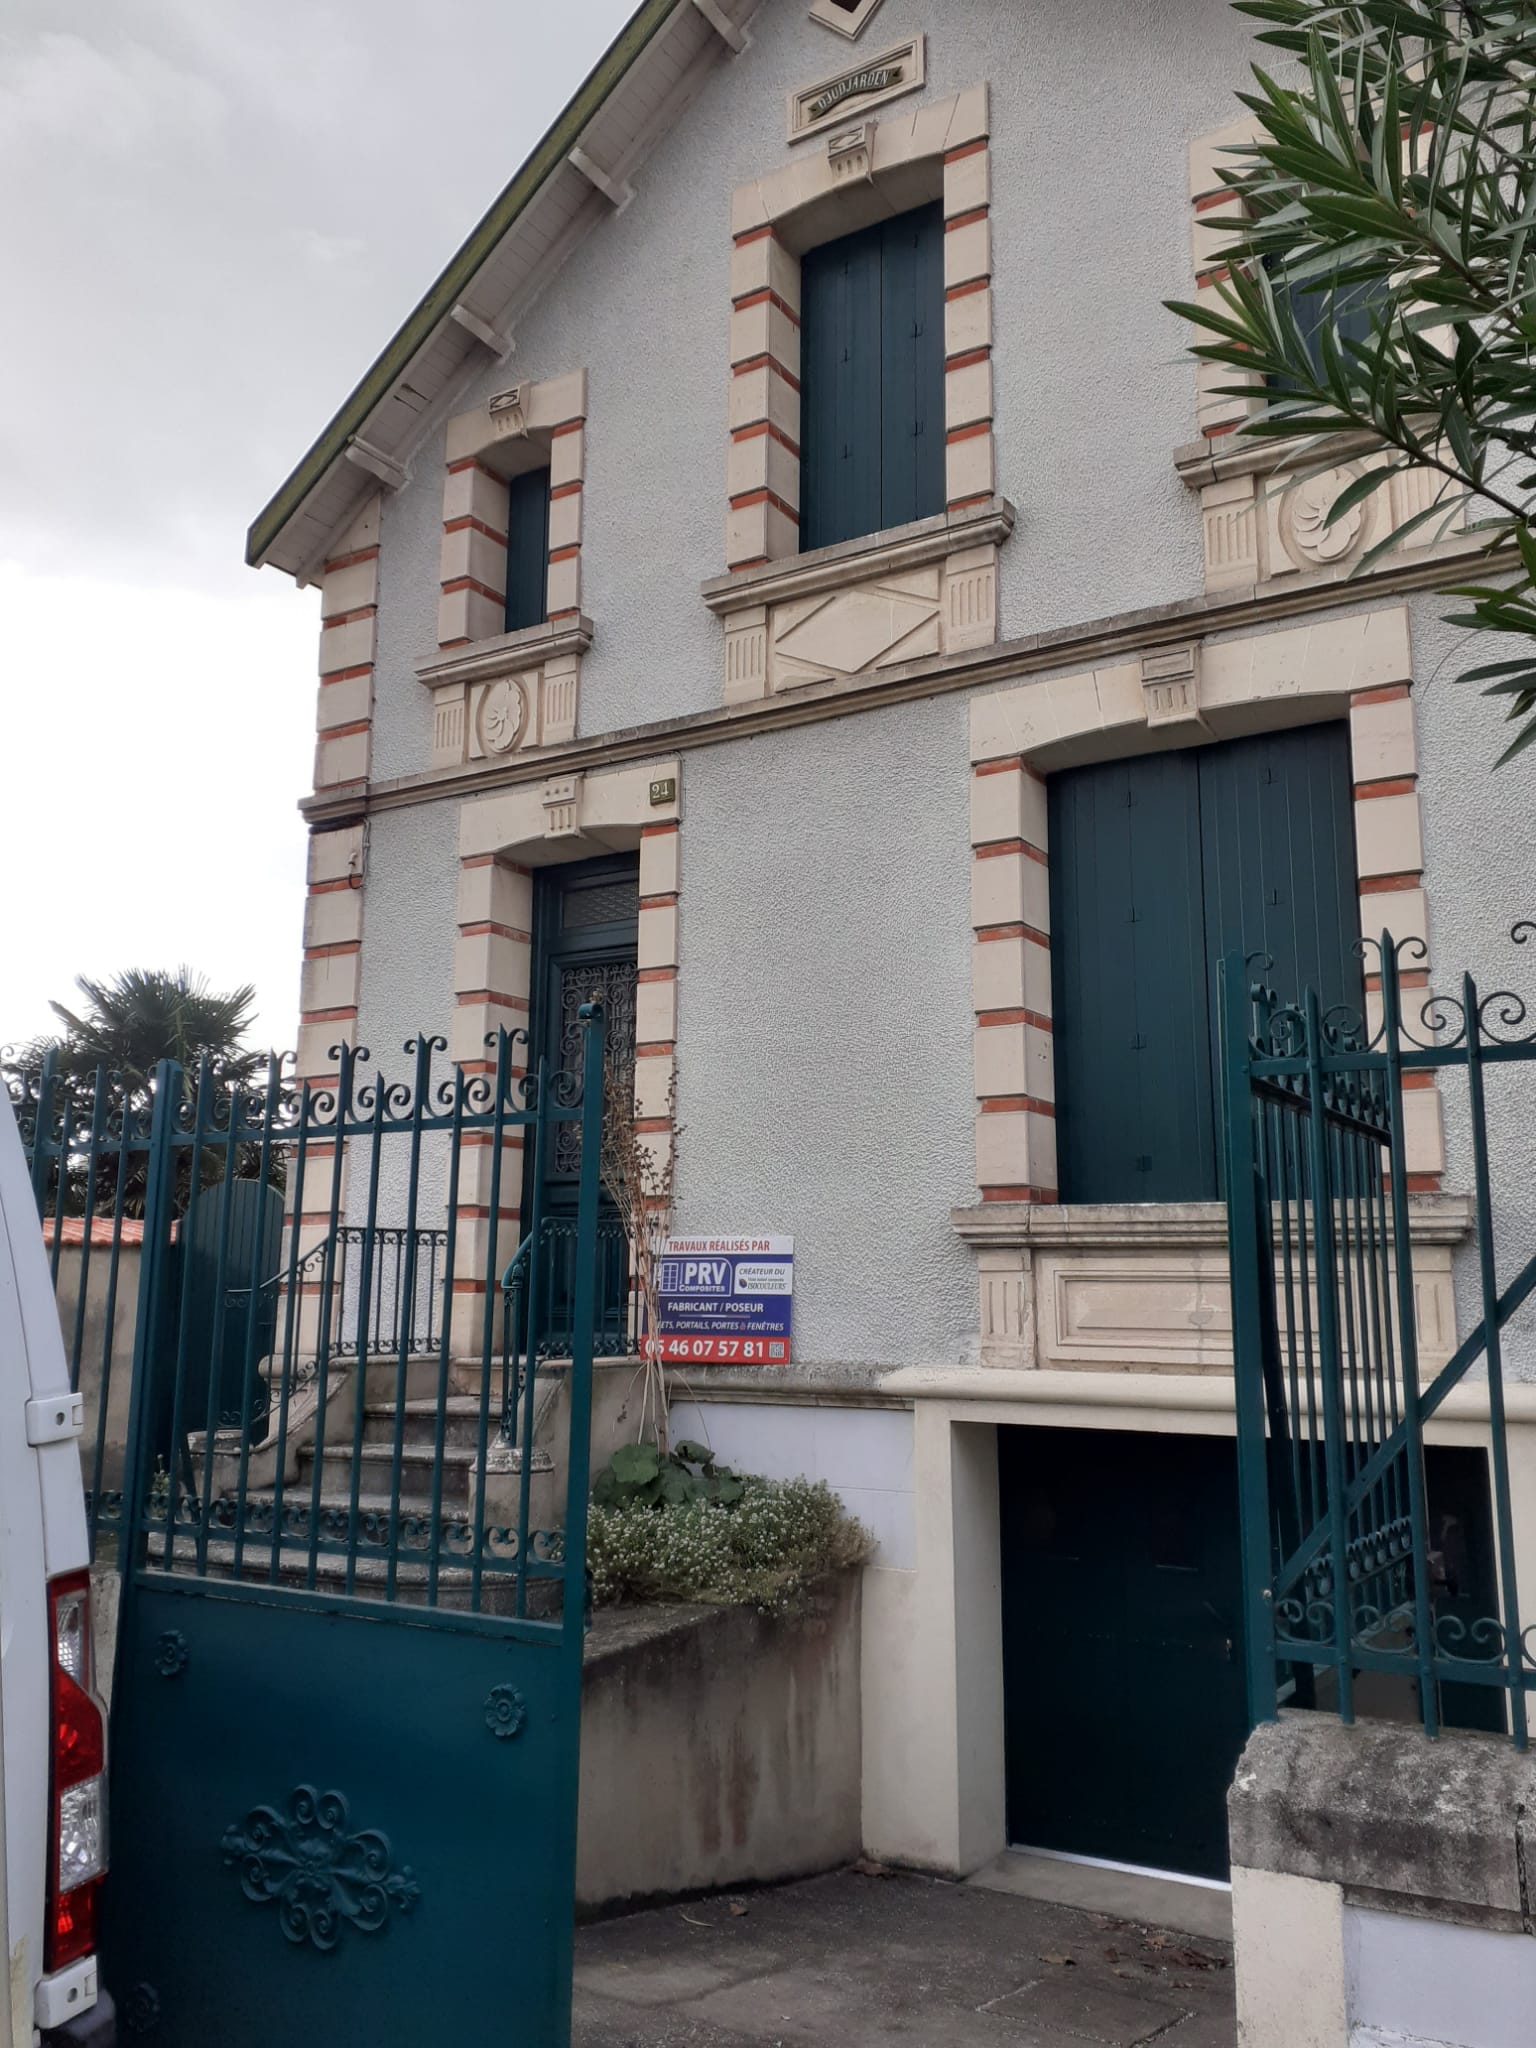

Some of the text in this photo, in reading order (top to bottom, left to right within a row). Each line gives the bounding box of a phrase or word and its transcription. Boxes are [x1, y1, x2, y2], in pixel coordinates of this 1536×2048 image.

[652, 781, 669, 799] 24
[669, 1240, 770, 1251] TRAVAUX RÉALISÉS PAR
[685, 1262, 727, 1285] PRV
[739, 1267, 773, 1275] CRÉATEUR
[668, 1302, 717, 1312] FABRICANT
[725, 1302, 764, 1313] POSEUR
[676, 1321, 710, 1330] PORTAILS,
[711, 1321, 739, 1330] PORTES
[747, 1320, 784, 1331] FENÊTRES
[668, 1339, 689, 1356] 46
[692, 1340, 714, 1357] 07
[718, 1340, 739, 1357] 57
[743, 1341, 764, 1358] 81
